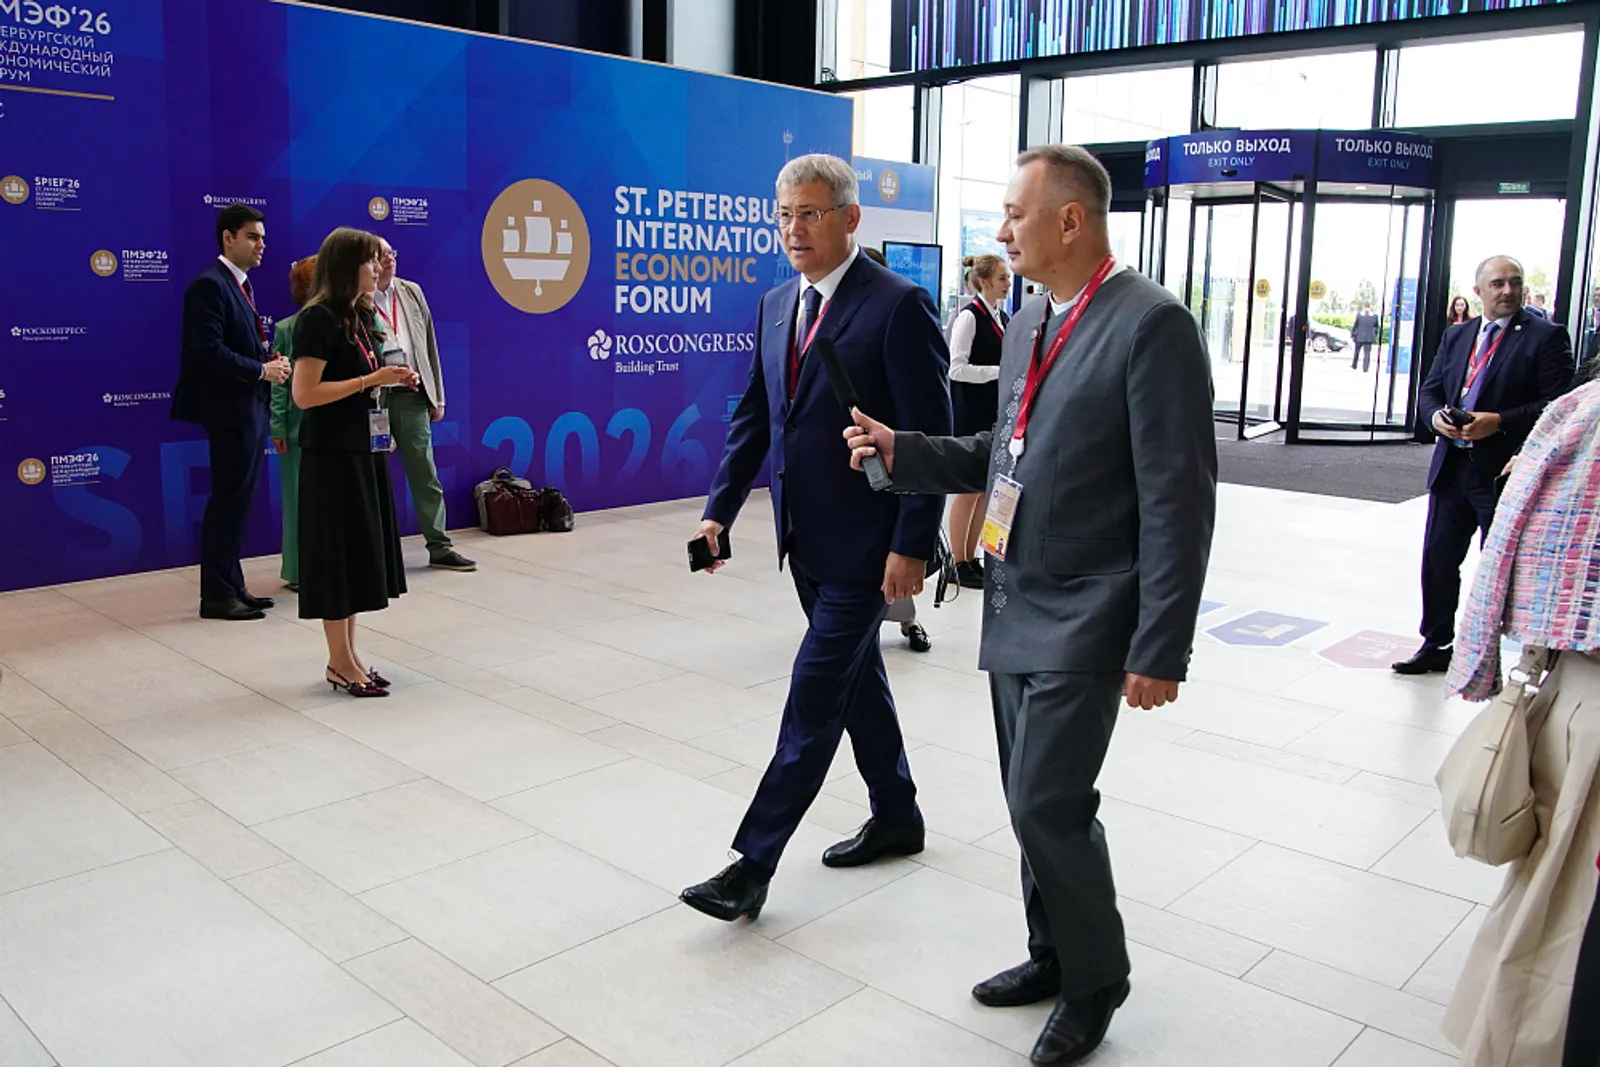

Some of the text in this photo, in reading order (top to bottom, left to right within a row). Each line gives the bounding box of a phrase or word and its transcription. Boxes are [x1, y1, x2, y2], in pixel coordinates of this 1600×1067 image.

[1183, 138, 1291, 156] ТОЛЬКО ВЫХОД
[1335, 138, 1433, 160] ТОЛЬКО ВЫХОД
[1208, 156, 1256, 168] EXIT ONLY
[1367, 157, 1411, 170] EXIT ONLY
[615, 185, 779, 225] ST. PETERSBU
[616, 219, 784, 255] INTERNATION
[615, 252, 757, 283] ECONOMIC
[615, 285, 712, 314] FORUM
[615, 333, 755, 356] ROSCONGRESS
[615, 359, 679, 375] Building Trust
[482, 403, 711, 494] 2026
